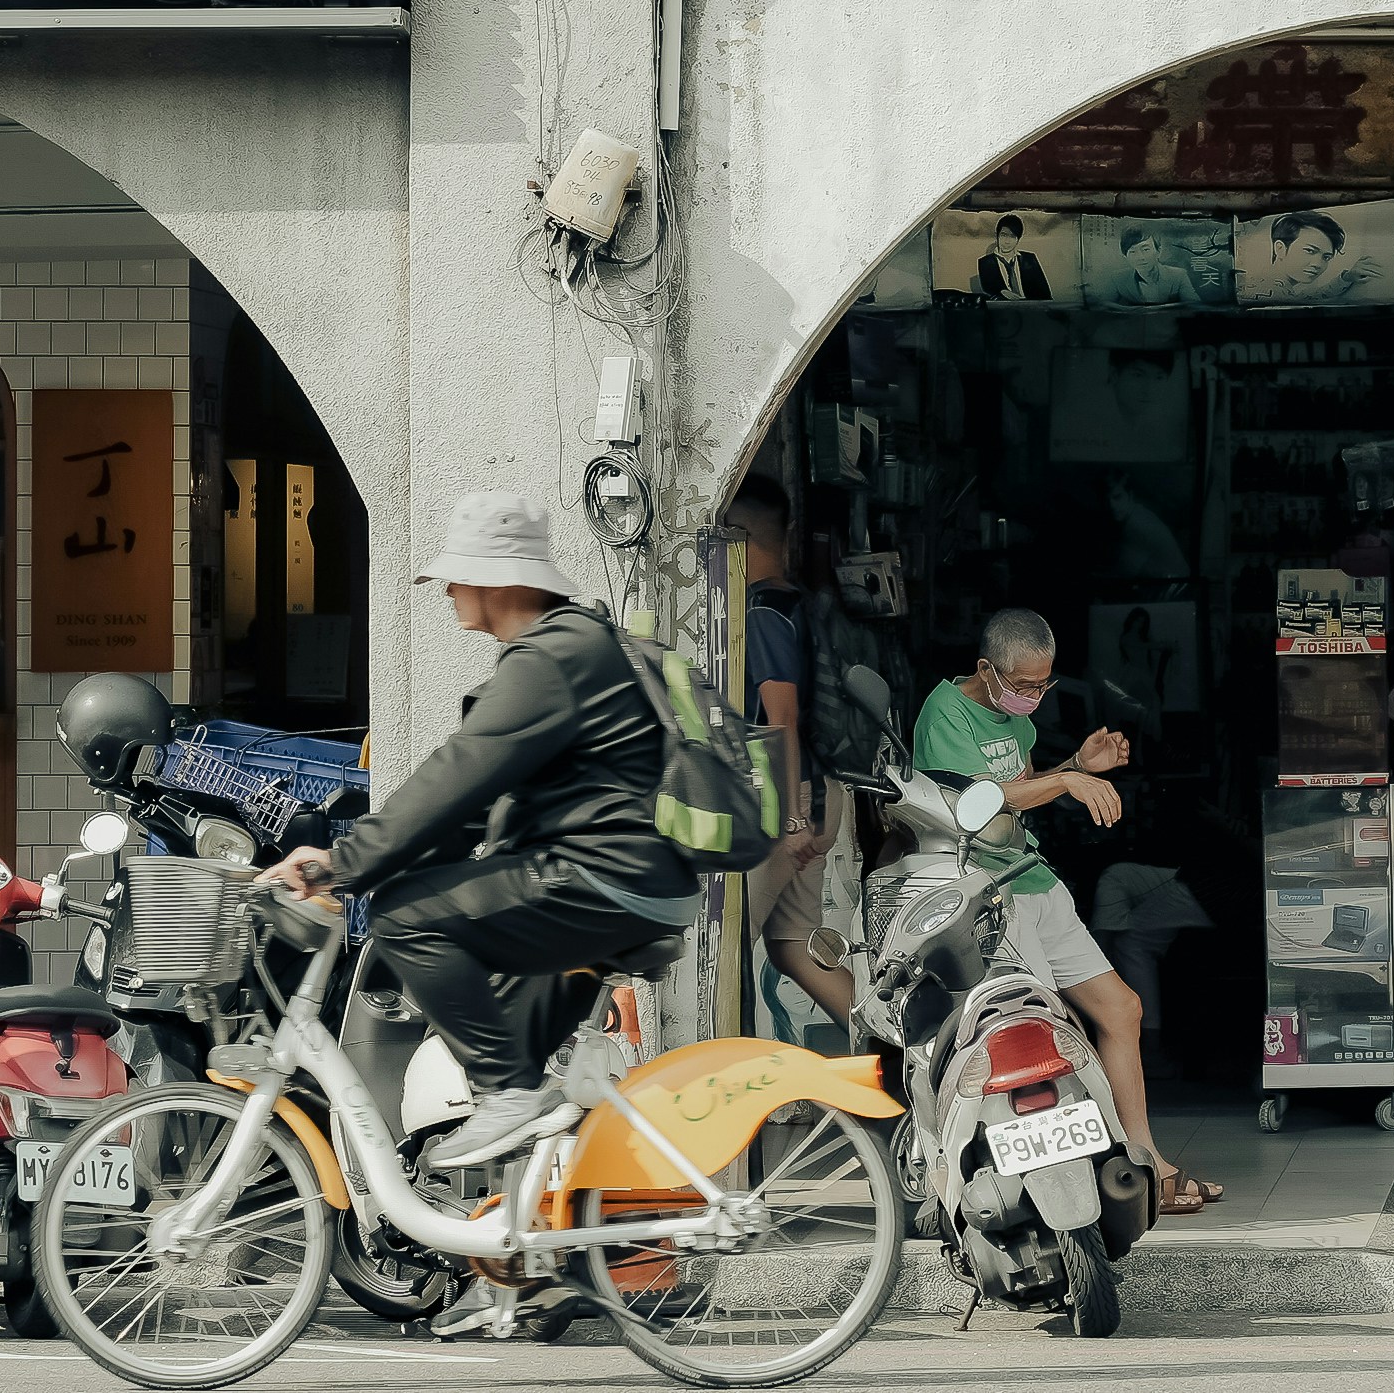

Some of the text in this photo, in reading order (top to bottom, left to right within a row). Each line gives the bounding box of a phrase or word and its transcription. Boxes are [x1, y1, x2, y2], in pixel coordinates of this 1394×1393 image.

[63, 441, 136, 558] 丁山
[56, 614, 147, 626] DING SHAN
[66, 635, 137, 647] Since 1909
[1297, 642, 1365, 654] TOSHIBA
[1310, 776, 1358, 785] BATTERIES
